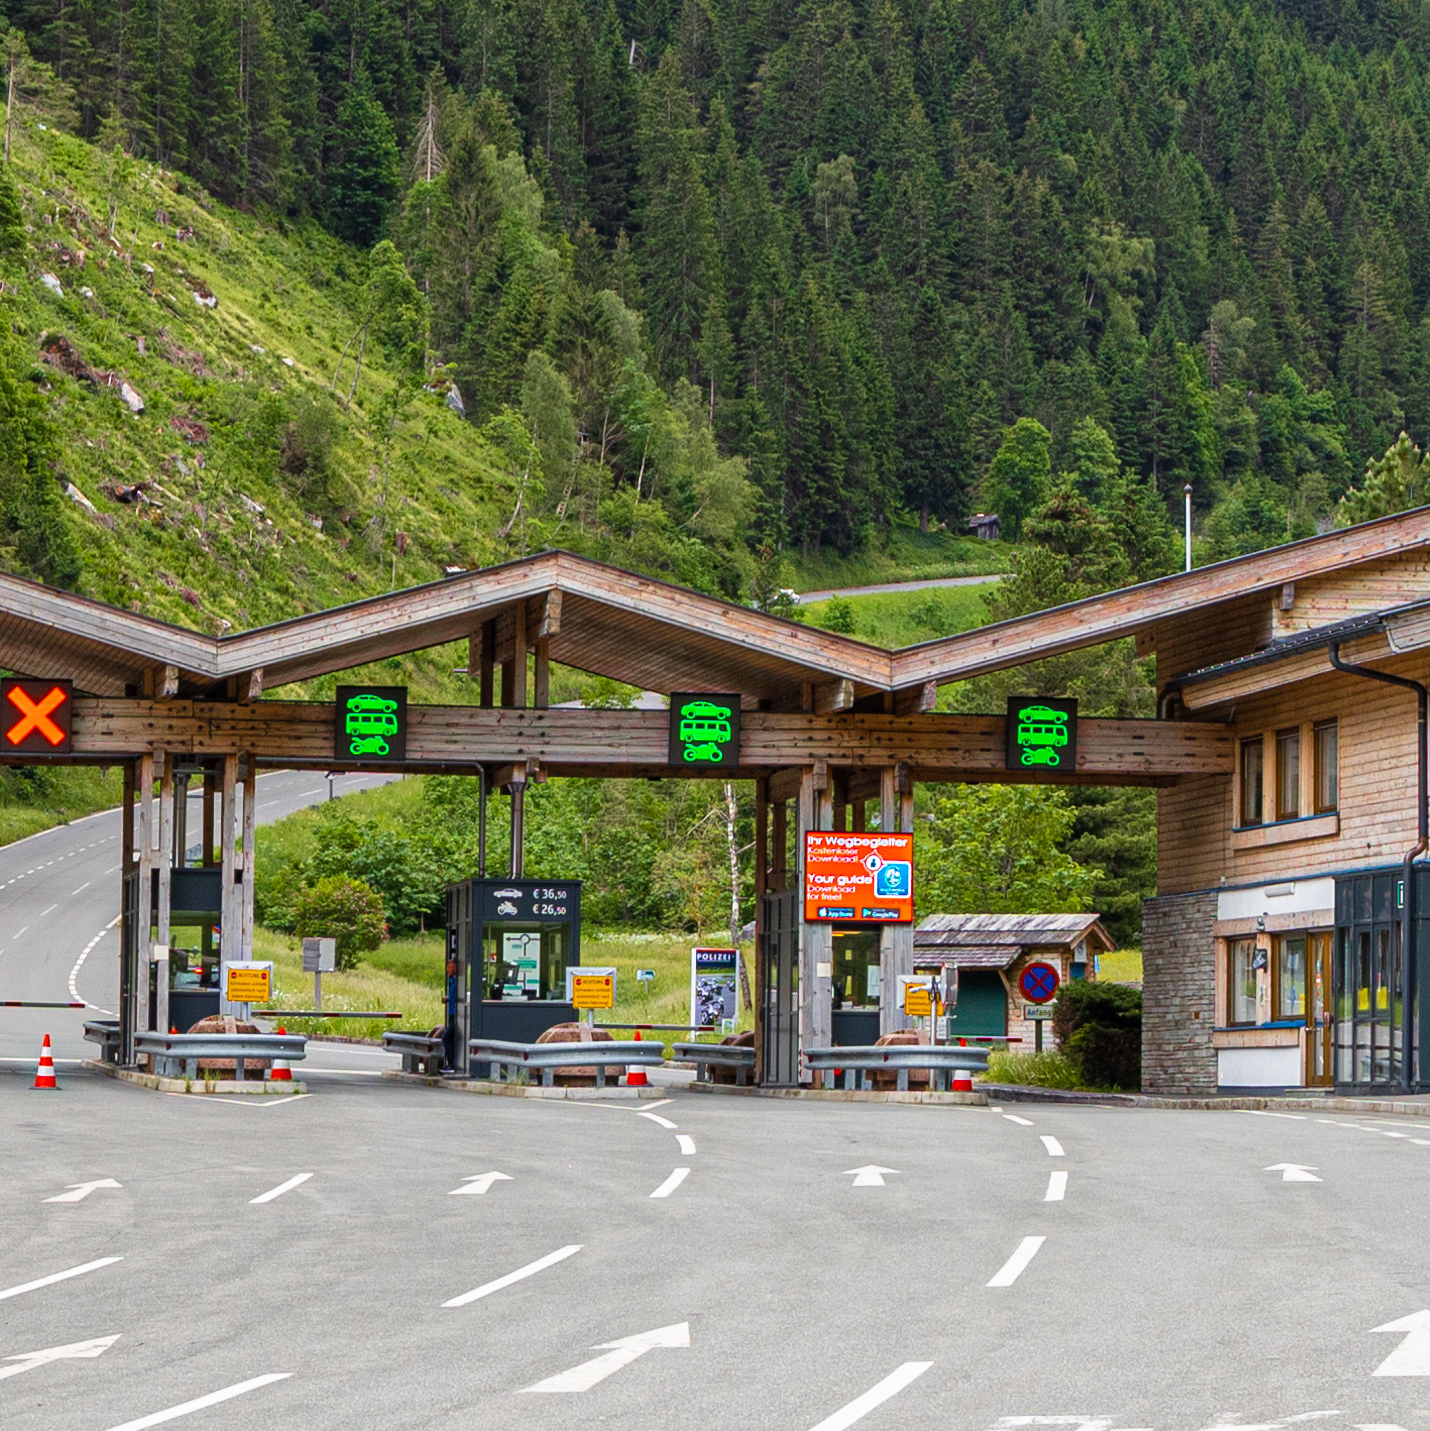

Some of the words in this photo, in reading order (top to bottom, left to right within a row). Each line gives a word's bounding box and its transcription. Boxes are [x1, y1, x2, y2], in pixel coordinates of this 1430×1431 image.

[807, 835, 823, 845] Ihr
[825, 836, 908, 848] Wegbegleiter
[807, 847, 859, 855] Kostenloser
[807, 873, 835, 883] Your
[837, 874, 873, 886] guide
[807, 884, 856, 893] Download
[542, 888, 567, 901] 36,50
[541, 903, 567, 916] 26,50
[696, 953, 731, 961] POLIZEI
[1026, 1008, 1052, 1017] Anfang
